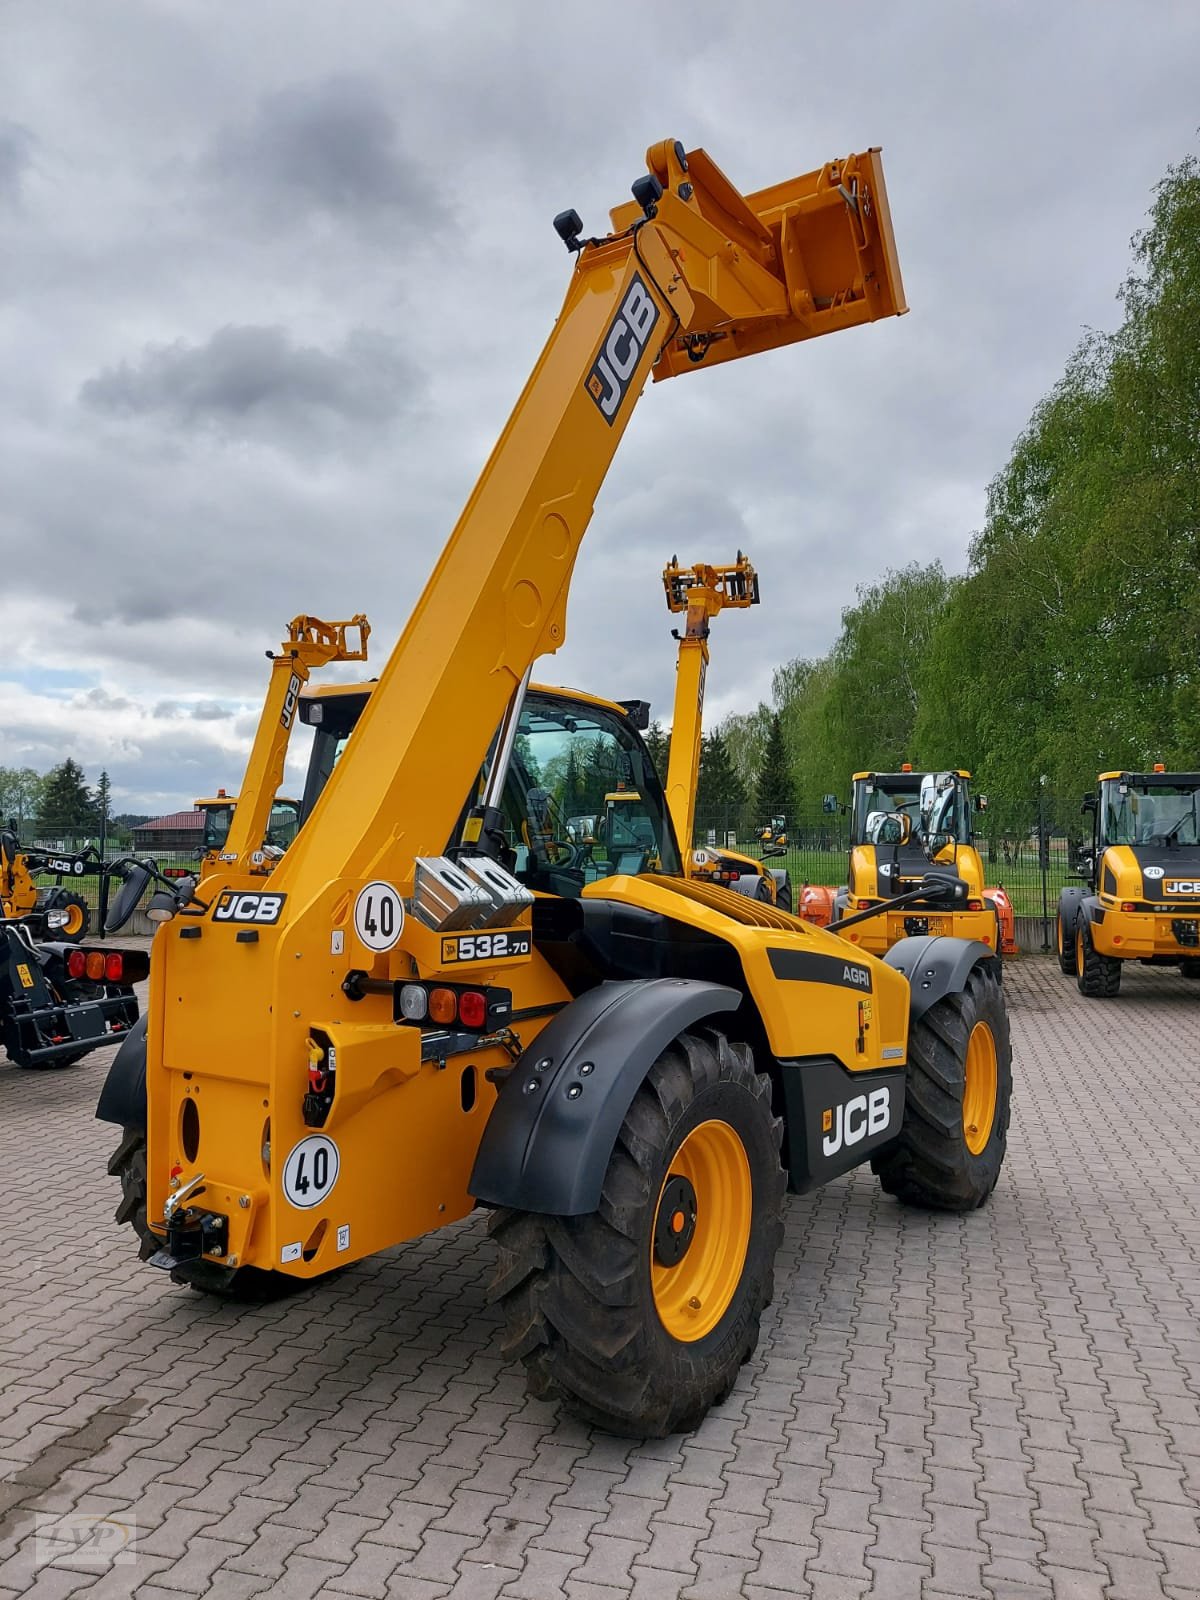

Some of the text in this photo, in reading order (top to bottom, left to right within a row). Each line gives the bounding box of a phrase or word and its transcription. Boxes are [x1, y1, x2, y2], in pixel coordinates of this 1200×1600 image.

[597, 281, 656, 416] JCB
[282, 674, 300, 729] JCB
[48, 859, 71, 873] JCB
[696, 853, 705, 863] 40
[215, 894, 281, 921] JCB
[364, 895, 394, 937] 40
[843, 965, 869, 987] AGRI
[823, 1086, 890, 1158] JCB
[295, 1148, 329, 1195] 40
